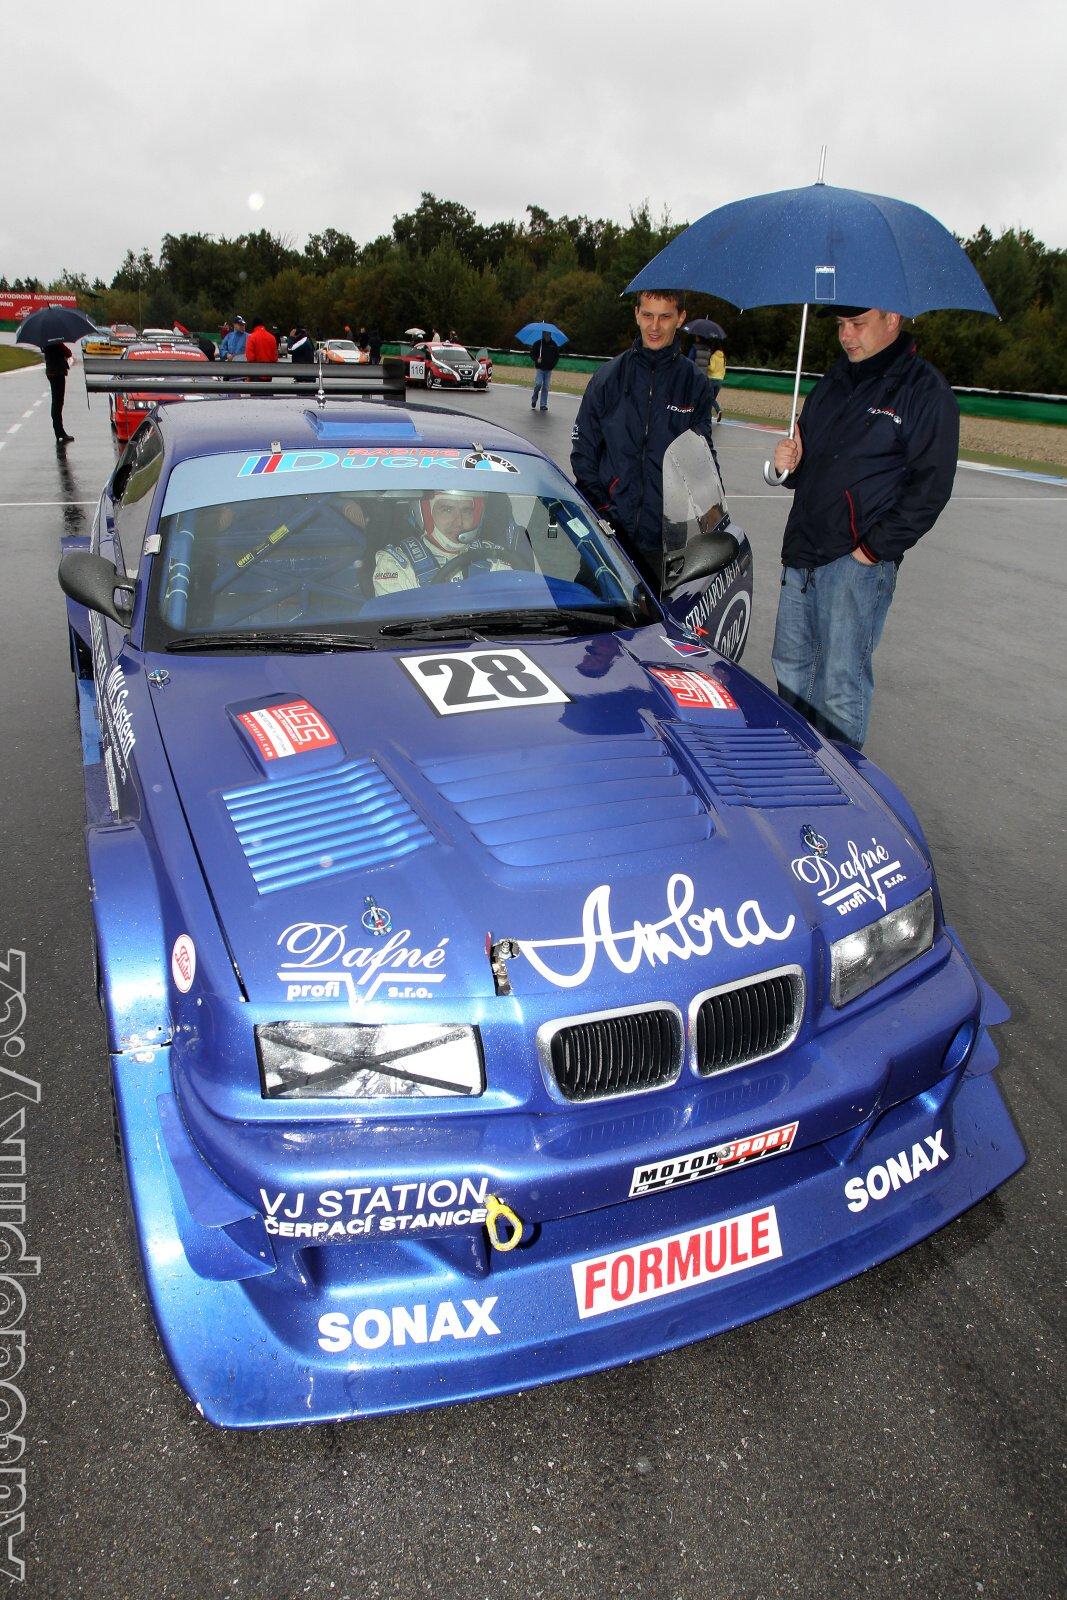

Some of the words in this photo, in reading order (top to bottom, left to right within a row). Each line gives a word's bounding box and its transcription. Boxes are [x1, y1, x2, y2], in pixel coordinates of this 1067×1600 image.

[411, 365, 424, 375] 116
[417, 655, 549, 706] 28
[791, 838, 889, 896] Dafné
[278, 923, 450, 985] Dafné
[518, 874, 795, 987] Ambra
[287, 981, 340, 1000] profi
[388, 986, 433, 998] s.r.o.
[260, 1188, 304, 1218] VJ
[316, 1177, 489, 1217] STATION
[844, 1129, 949, 1212] SONAX
[264, 1215, 375, 1238] ČERPACÍ
[378, 1208, 488, 1231] STANICE
[585, 1212, 770, 1310] FORMULE
[318, 1296, 502, 1352] SONAX
